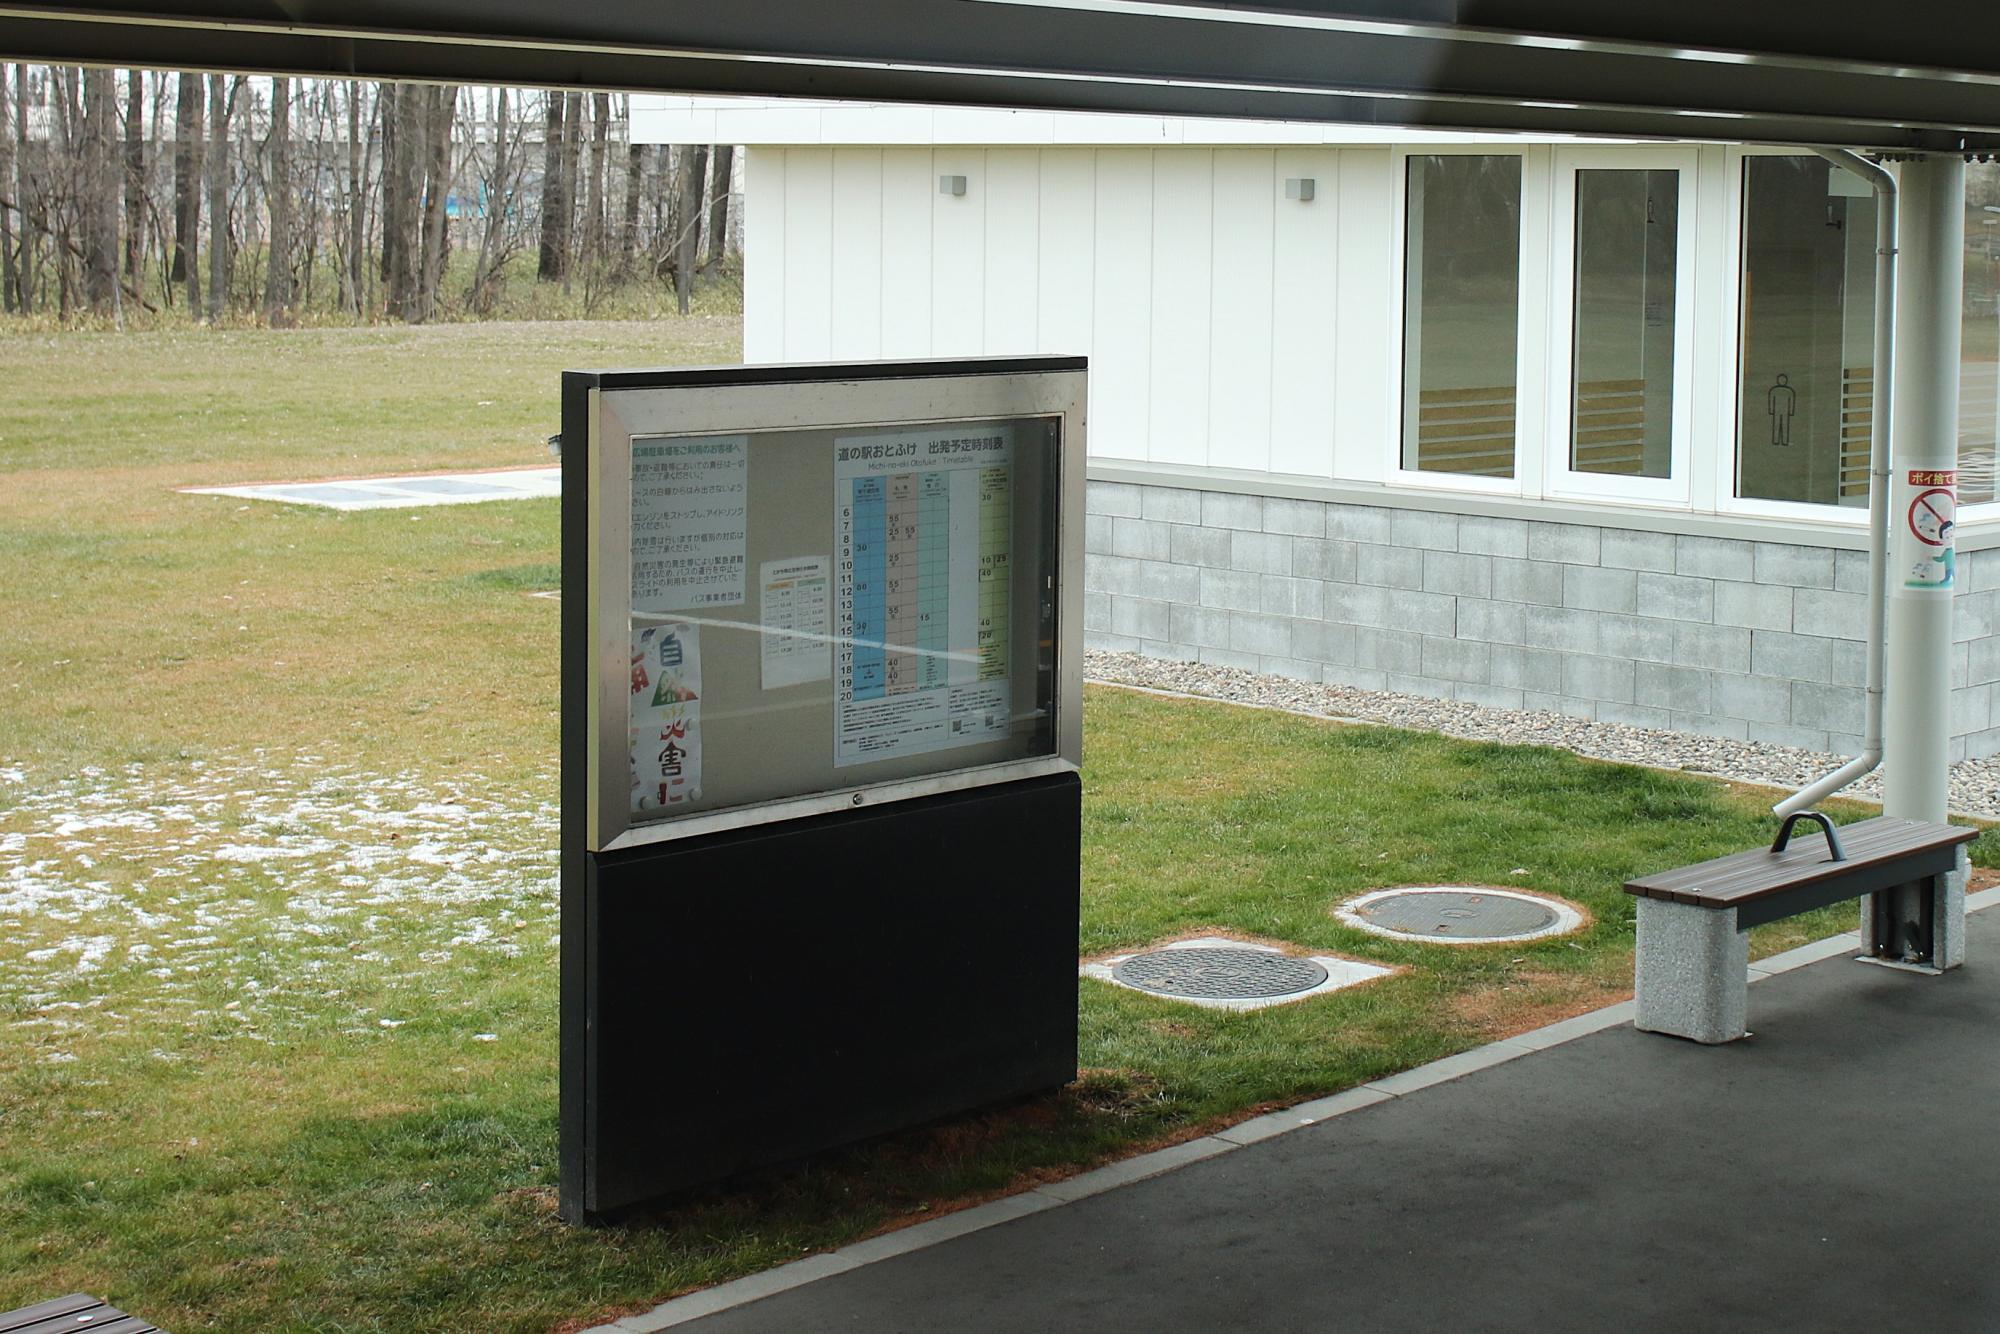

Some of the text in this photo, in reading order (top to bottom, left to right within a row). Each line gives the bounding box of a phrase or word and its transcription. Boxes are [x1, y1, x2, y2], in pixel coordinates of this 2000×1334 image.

[838, 436, 1004, 462] 道の駅おとふけ 出発予定時刻表
[1912, 472, 1957, 486] ポイ捨て
[632, 484, 744, 497] ースの白線からはみ出さないよう
[843, 508, 850, 517] 6
[843, 521, 850, 531] 7
[843, 535, 850, 544] 8
[843, 548, 850, 557] 9
[841, 561, 853, 570] 10
[841, 574, 852, 583] 11
[841, 587, 853, 596] 12
[841, 600, 853, 609] 13
[841, 613, 853, 622] 14
[841, 626, 853, 635] 15
[841, 652, 852, 661] 17
[841, 666, 852, 674] 18
[841, 679, 852, 688] 19
[840, 691, 852, 701] 20
